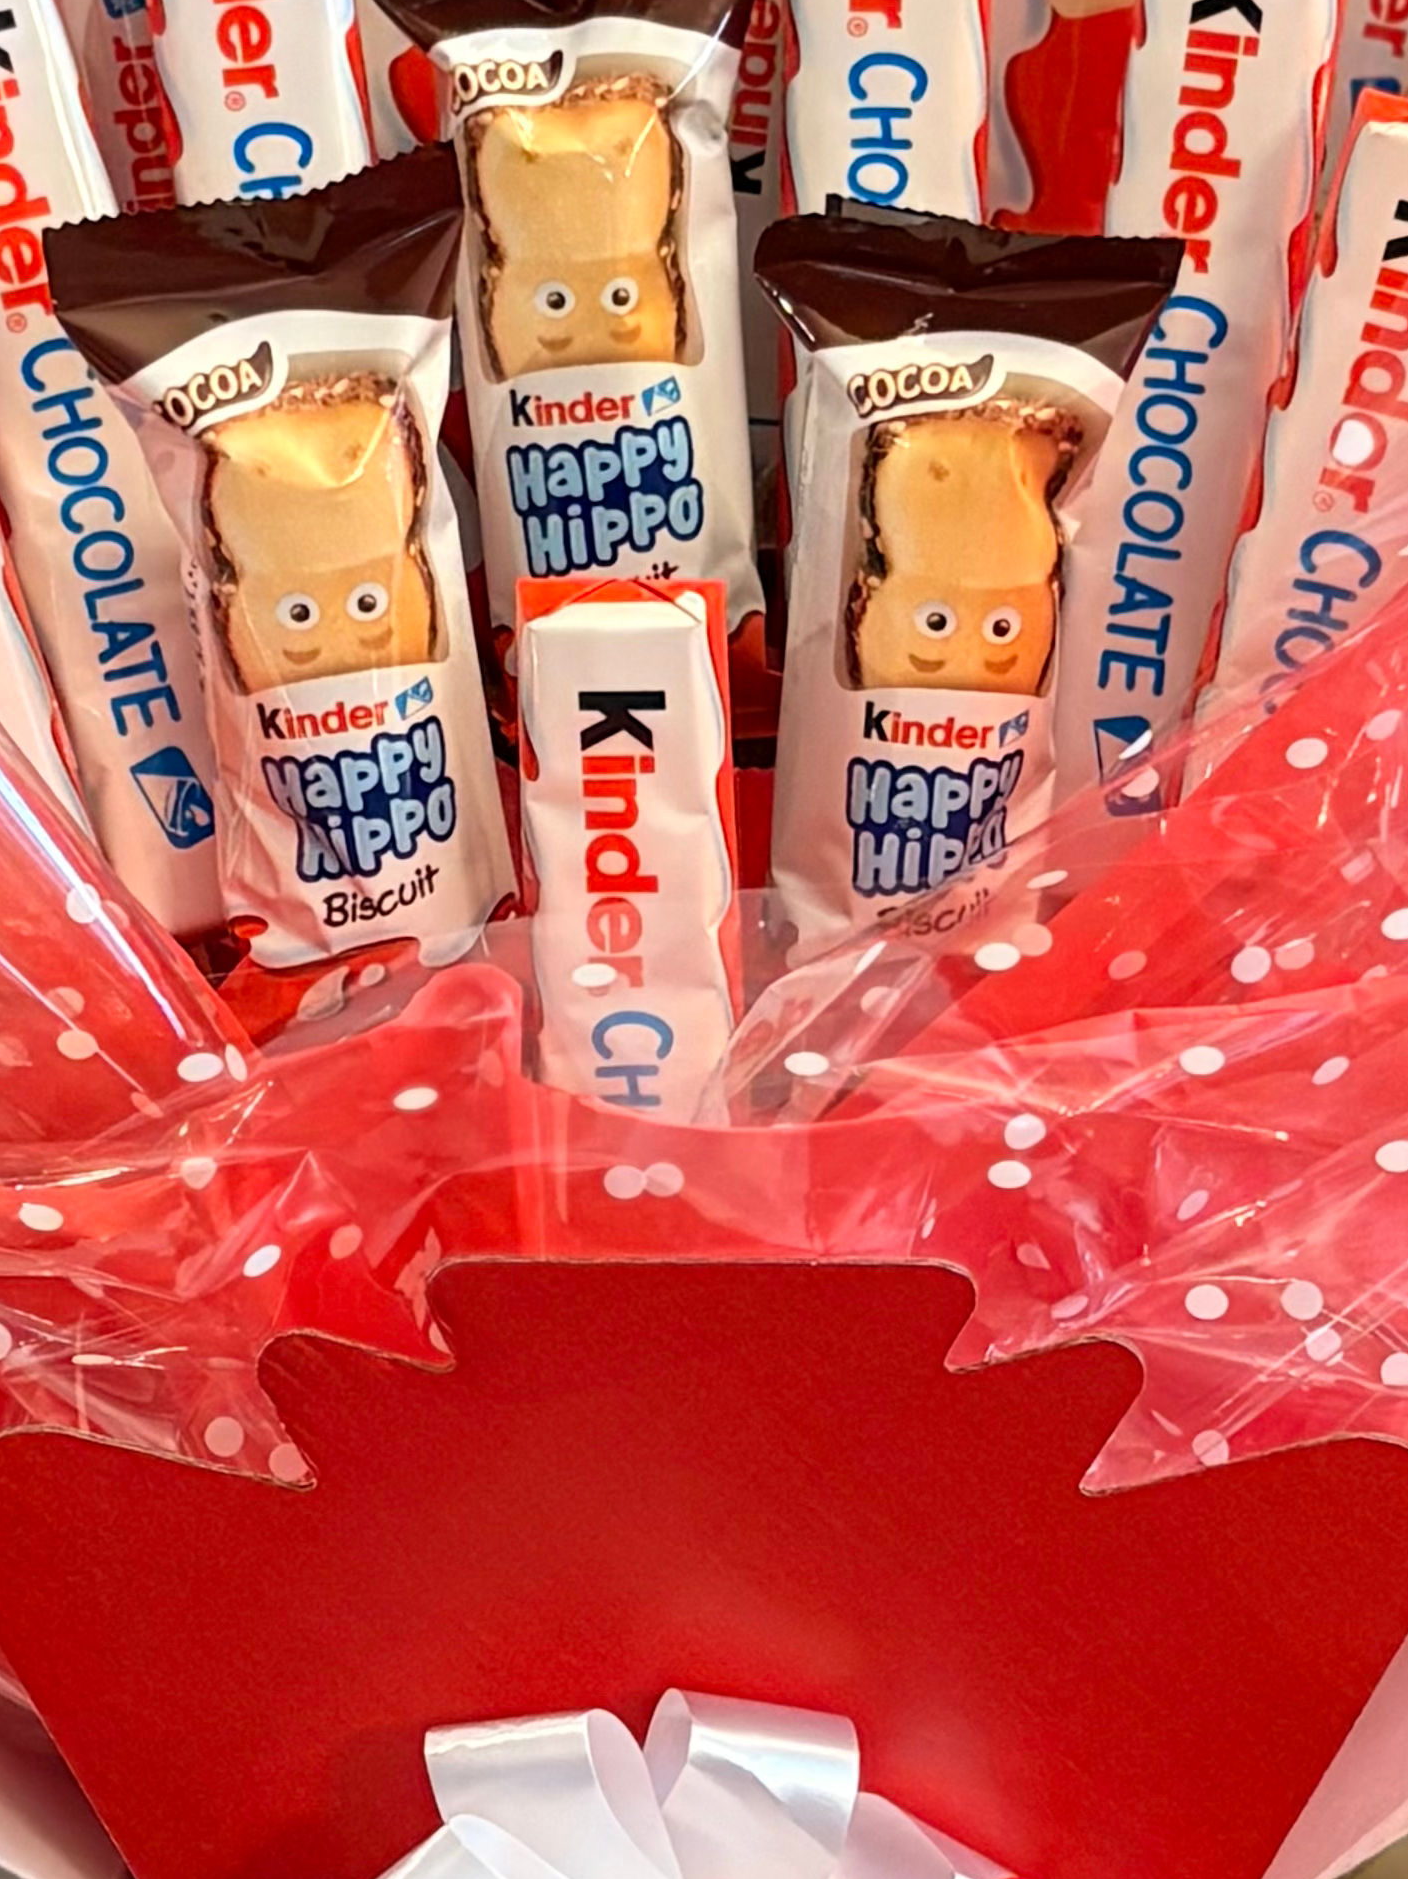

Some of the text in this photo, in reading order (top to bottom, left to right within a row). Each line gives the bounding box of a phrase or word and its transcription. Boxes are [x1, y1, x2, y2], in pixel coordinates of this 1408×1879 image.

[453, 59, 548, 111] OCOA
[154, 360, 262, 426] OCOA
[509, 388, 635, 428] Kinder
[848, 363, 975, 418] COCOA
[1097, 293, 1230, 698] CHOCOLATE
[20, 335, 183, 738] CHOCOLATE
[256, 699, 389, 742] Kinder
[863, 700, 994, 749] Kinder
[578, 690, 666, 988] Kinder
[323, 863, 440, 928] Biscuit
